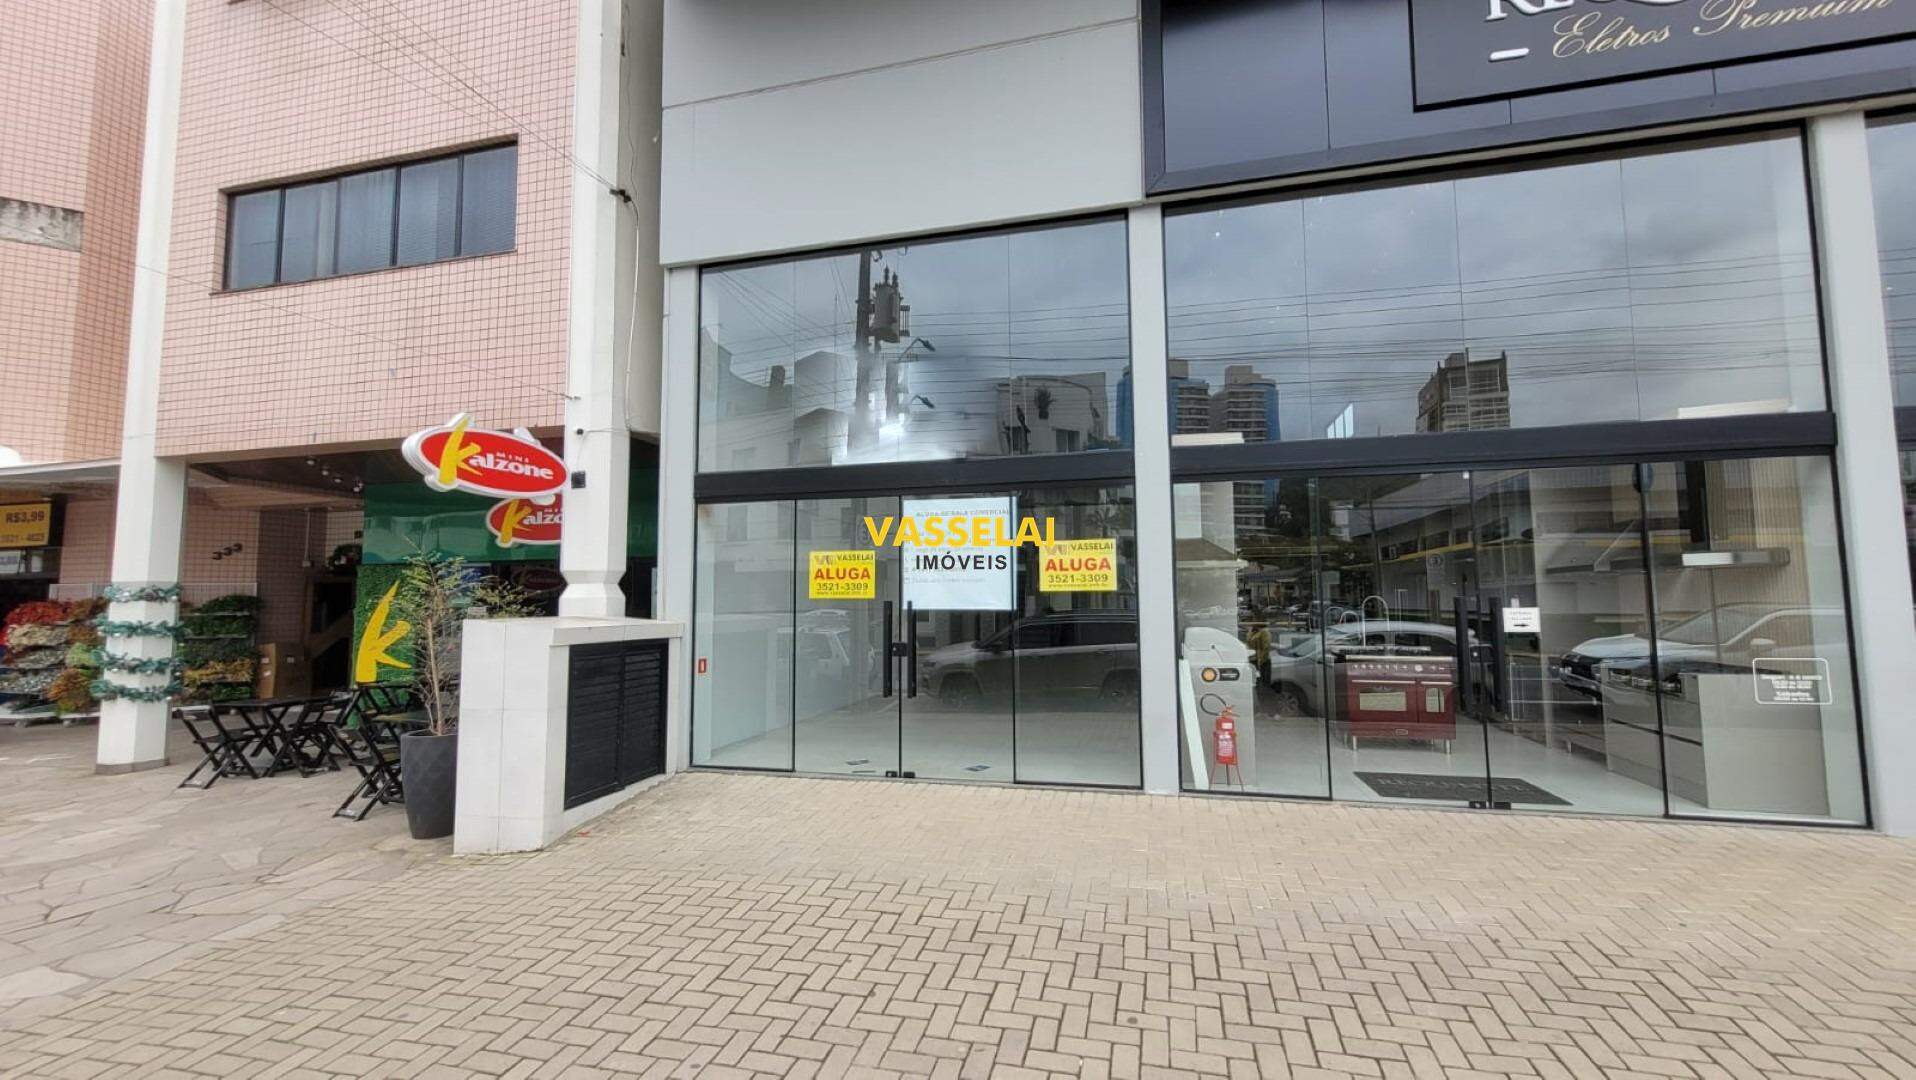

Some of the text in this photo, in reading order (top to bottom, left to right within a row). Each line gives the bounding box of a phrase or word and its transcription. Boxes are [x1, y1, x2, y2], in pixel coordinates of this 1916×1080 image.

[1552, 0, 1897, 58] Eletros Premium
[438, 418, 555, 485] Kalzone
[502, 499, 563, 543] Kalzo
[1070, 542, 1113, 551] VASSELAI
[836, 553, 874, 561] VASSELAI
[1045, 557, 1111, 572] ALUGA
[814, 566, 871, 580] ALUGA
[1047, 573, 1109, 584] 3521-3309
[816, 582, 869, 592] 3521-3309
